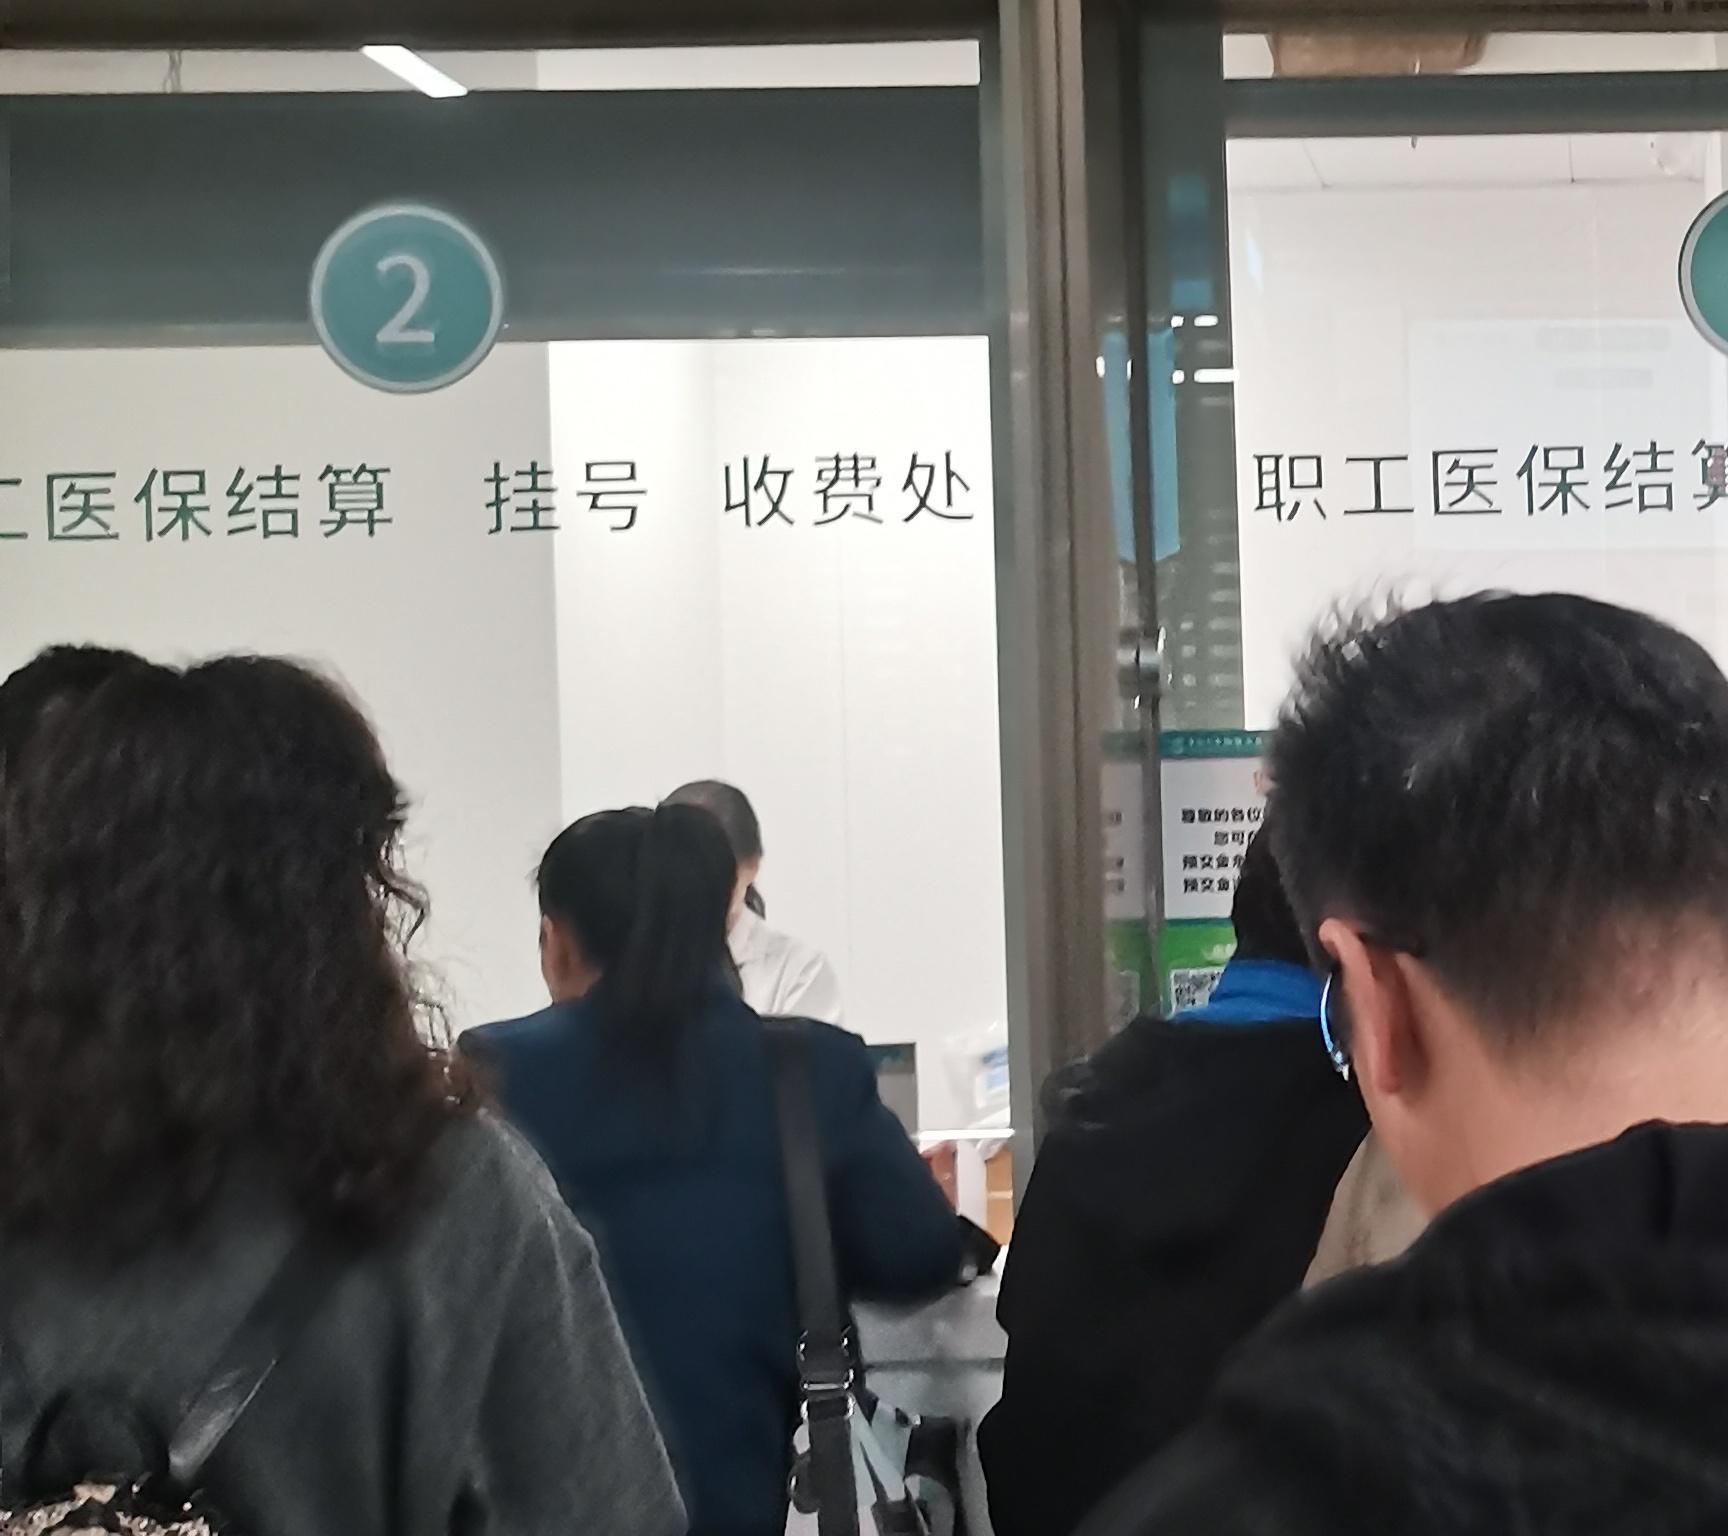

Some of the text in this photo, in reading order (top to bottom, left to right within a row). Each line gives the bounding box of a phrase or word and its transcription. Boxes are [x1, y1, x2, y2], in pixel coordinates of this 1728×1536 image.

[374, 253, 436, 346] 2
[484, 459, 649, 535] 挂号
[722, 450, 976, 528] 收费处
